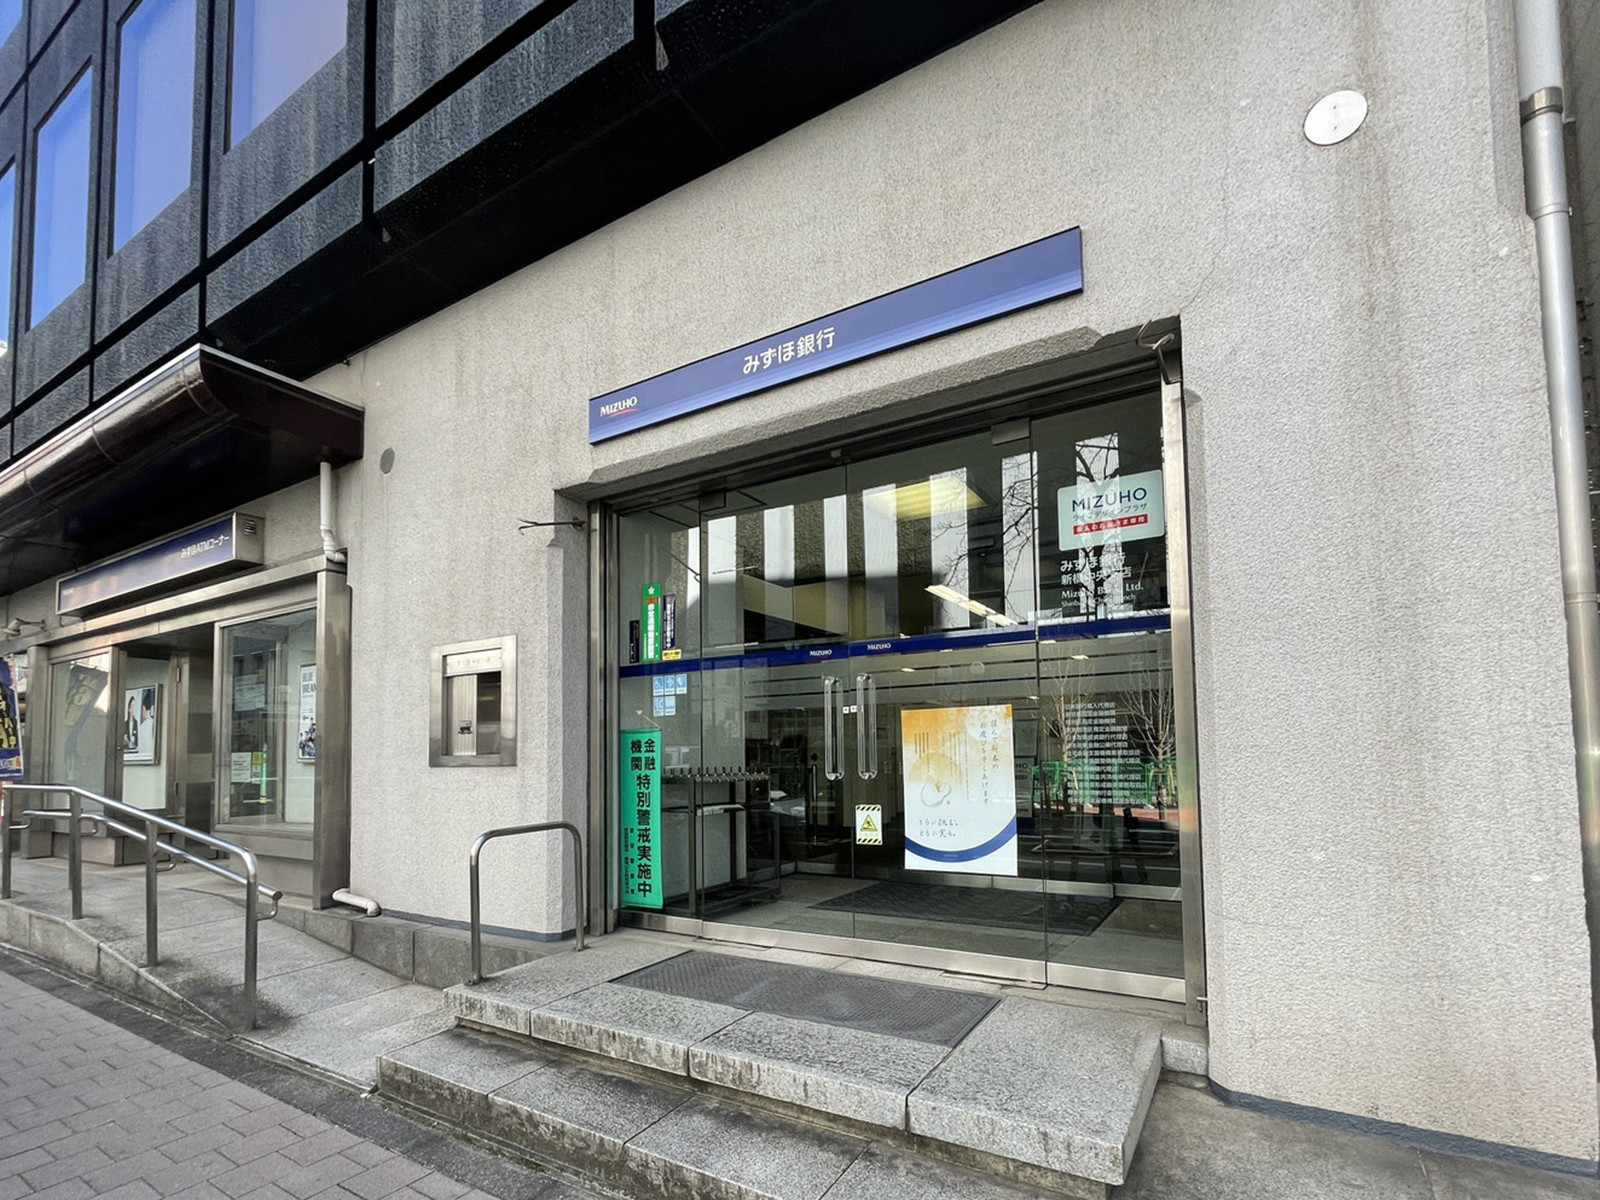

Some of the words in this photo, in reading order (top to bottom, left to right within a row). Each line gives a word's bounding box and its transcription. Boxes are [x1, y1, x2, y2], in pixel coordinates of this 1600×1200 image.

[743, 327, 835, 375] みずほ銀行
[600, 396, 638, 417] MIZUHO
[1072, 487, 1147, 512] MIZUHO
[1126, 581, 1144, 592] Ltd.
[810, 649, 832, 657] MIZUHO
[867, 642, 892, 650] MIZUHO
[636, 774, 653, 898] 特別警戒実施中
